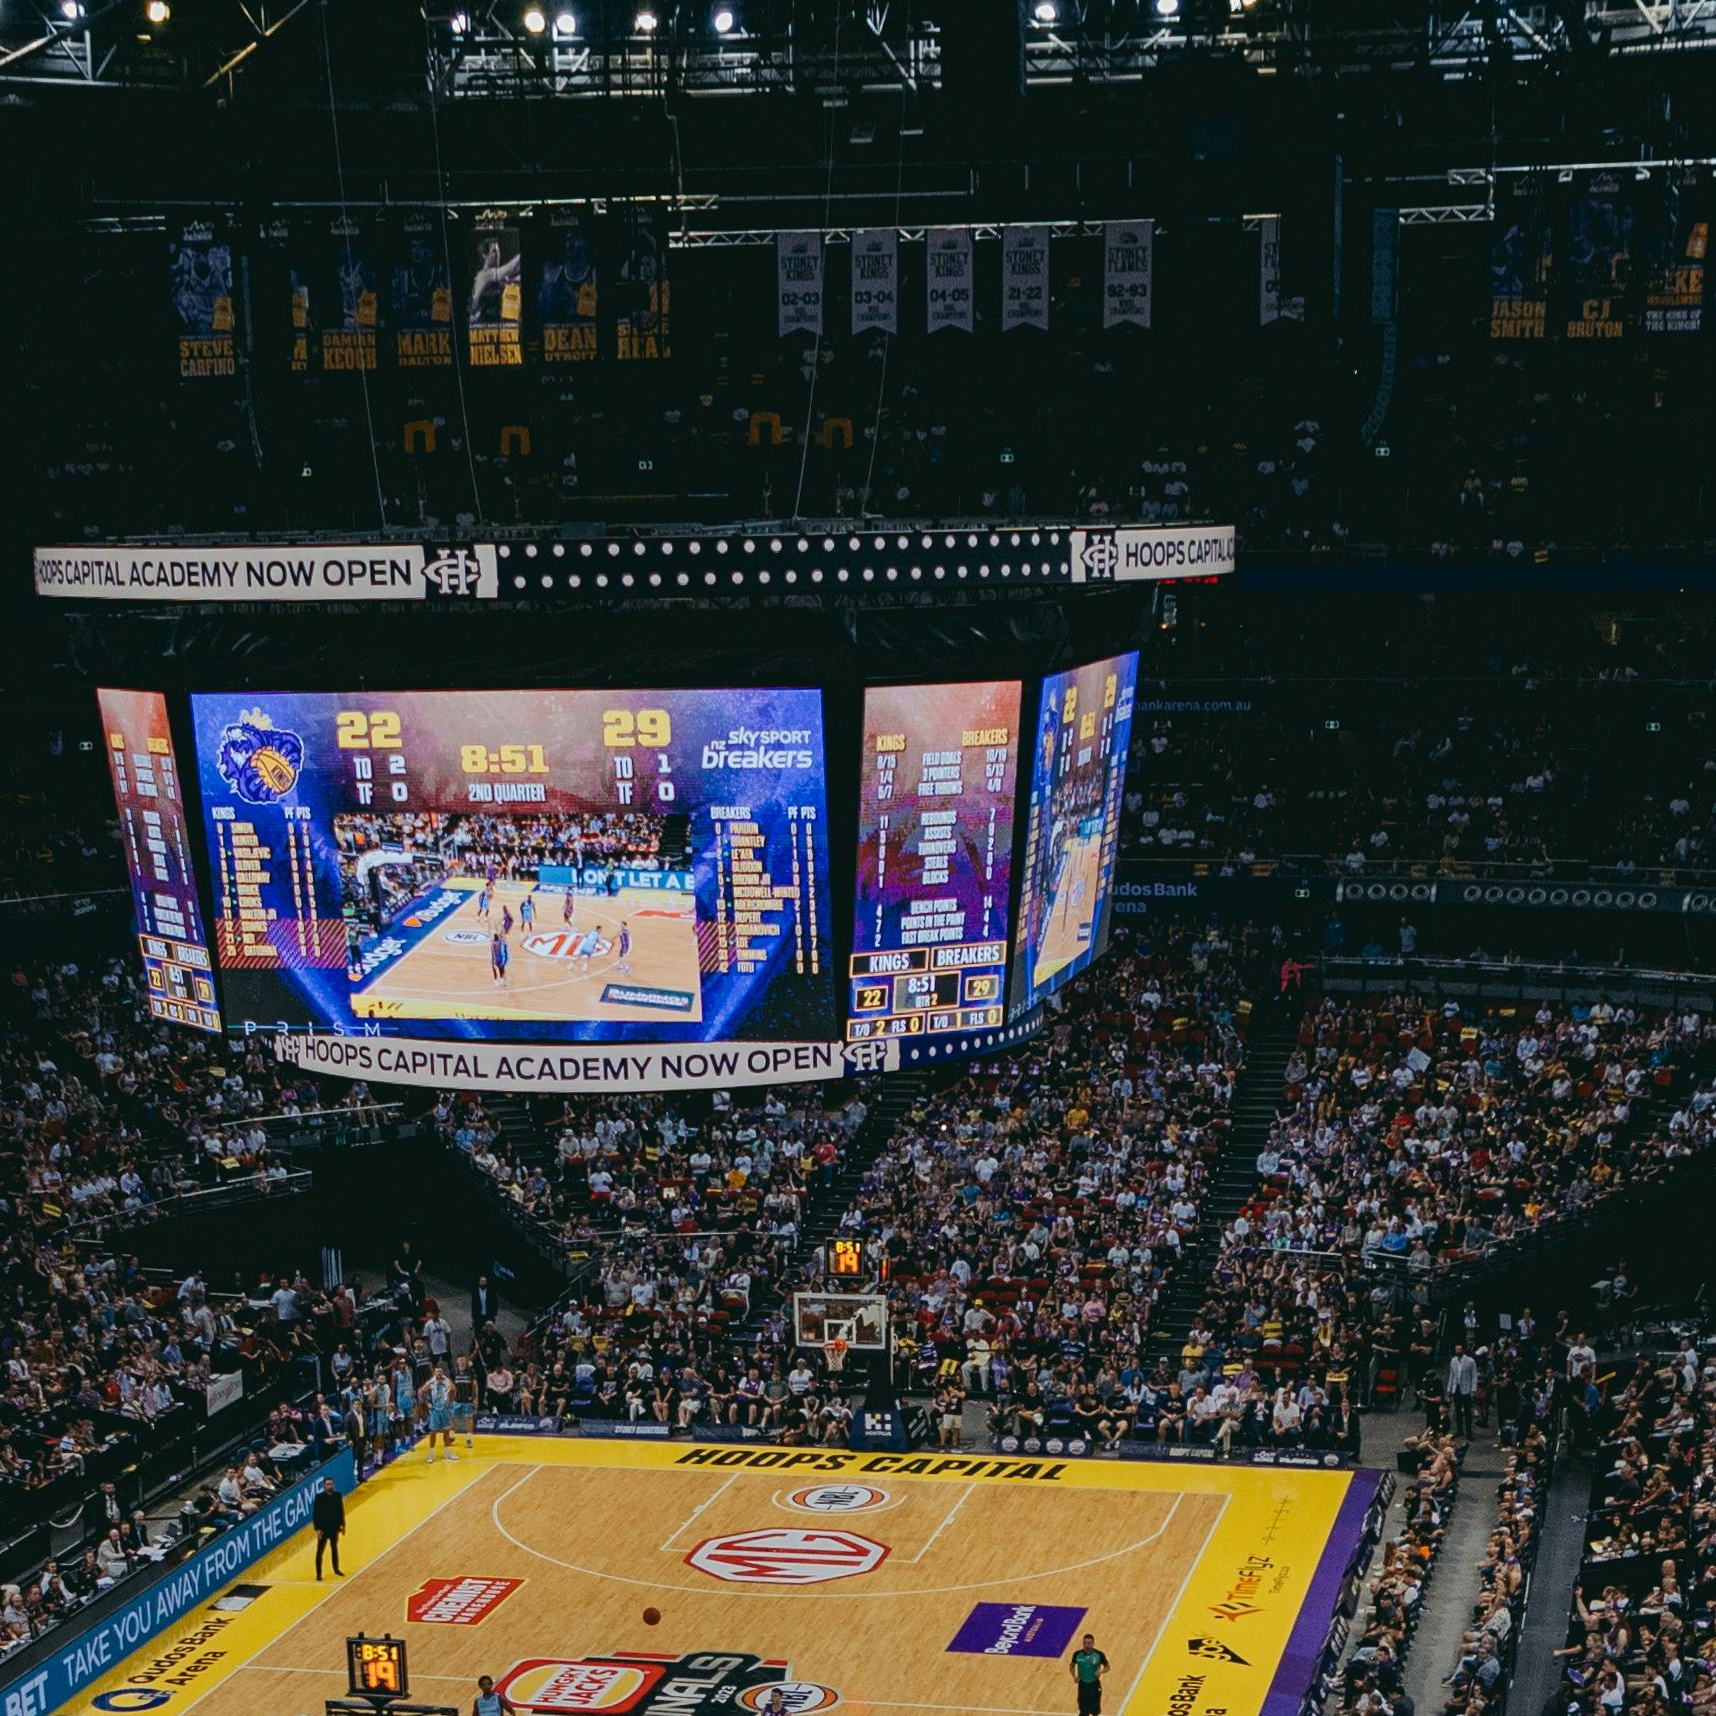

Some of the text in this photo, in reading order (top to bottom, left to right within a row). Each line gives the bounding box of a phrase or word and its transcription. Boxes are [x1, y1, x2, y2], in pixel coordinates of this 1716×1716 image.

[544, 327, 597, 350] DEAN
[1490, 319, 1546, 338] SMITH
[179, 339, 234, 358] STEVE
[398, 331, 451, 354] MARK
[470, 344, 522, 366] NIELSEN
[1126, 540, 1185, 568] HOOPS
[66, 558, 411, 587] CAPITAL ACADEMY NOW OPEN
[337, 711, 402, 748] 22
[602, 709, 672, 748] 29
[760, 729, 811, 744] SPORT
[962, 728, 1008, 746] BREAKERS
[876, 736, 906, 751] KINGS
[353, 754, 406, 779] TO 2
[461, 743, 549, 773] 8:51
[614, 754, 672, 779] TO 1
[701, 746, 812, 769] breakers
[357, 782, 408, 804] TF 0
[468, 782, 546, 804] 2ND QUARTER
[615, 781, 675, 804] TF 0
[710, 806, 751, 820] BREAKERS
[801, 806, 816, 819] PTS
[629, 871, 660, 888] LET
[1154, 882, 1197, 897] Bank
[869, 953, 909, 972] KINGS
[937, 945, 999, 966] BREAKERS
[908, 977, 935, 993] 8:51
[973, 980, 990, 996] 29
[863, 990, 881, 1007] 22
[876, 1017, 920, 1035] 2 FLS 0
[956, 1010, 996, 1027] 1 FLS 0
[305, 1037, 833, 1081] HOOPS CAPITAL ACADEMY NOW OPEN
[675, 1448, 1068, 1481] HOOPS CAPITAL
[814, 1485, 859, 1507] NBL
[705, 1532, 872, 1580] MG
[62, 1629, 112, 1687] TAKE
[113, 1607, 152, 1650] YOU
[155, 1572, 202, 1630] AWAY
[204, 1534, 251, 1587] FROM
[252, 1507, 283, 1546] THE
[284, 1475, 325, 1528] GAME
[421, 1578, 493, 1622] CHEMIST
[454, 1581, 511, 1624] WAREHOUSE
[128, 1615, 236, 1685] Qudos Bank
[361, 1644, 398, 1662] 8:51
[165, 1649, 229, 1687] Arena
[366, 1660, 397, 1690] 19
[535, 1666, 584, 1704] HUNGRY
[568, 1669, 619, 1706] JACKS
[711, 1684, 738, 1705] 2023
[1169, 1674, 1206, 1708] Bank
